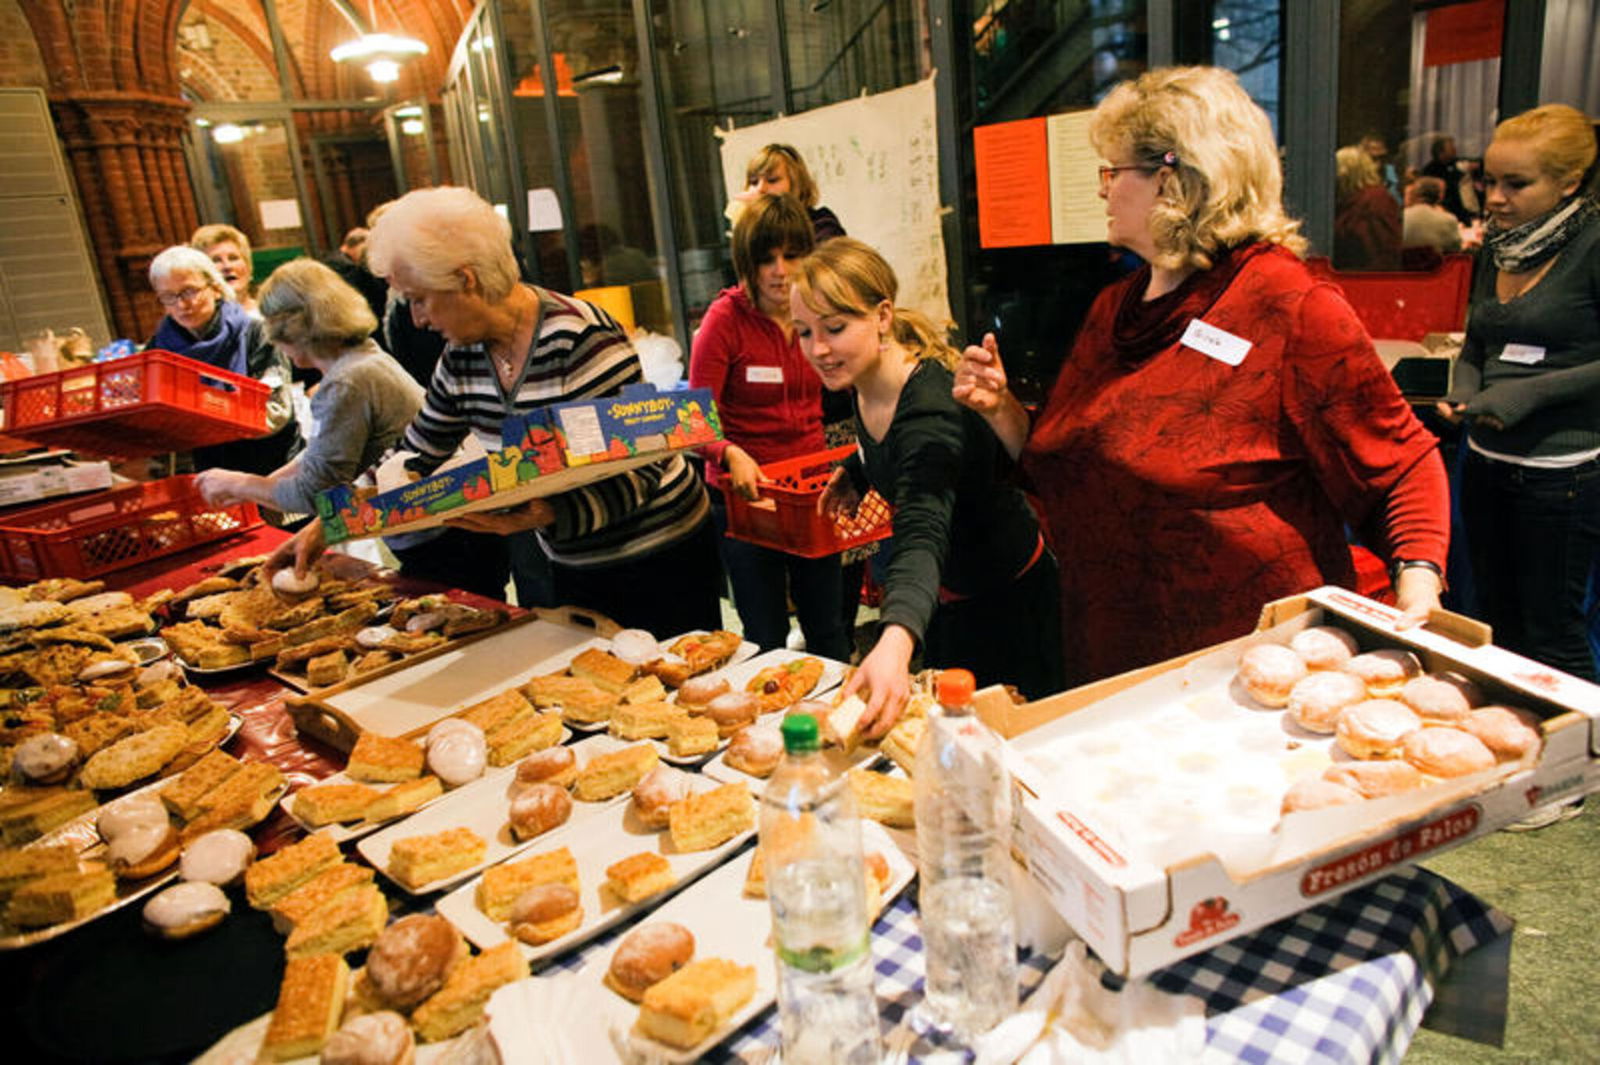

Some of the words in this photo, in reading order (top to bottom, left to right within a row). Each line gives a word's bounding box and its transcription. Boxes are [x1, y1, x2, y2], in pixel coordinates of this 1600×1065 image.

[611, 397, 672, 419] SUNNYBOY
[1308, 851, 1383, 892] Fresón
[1388, 839, 1413, 860] de
[1419, 815, 1474, 848] Palos
